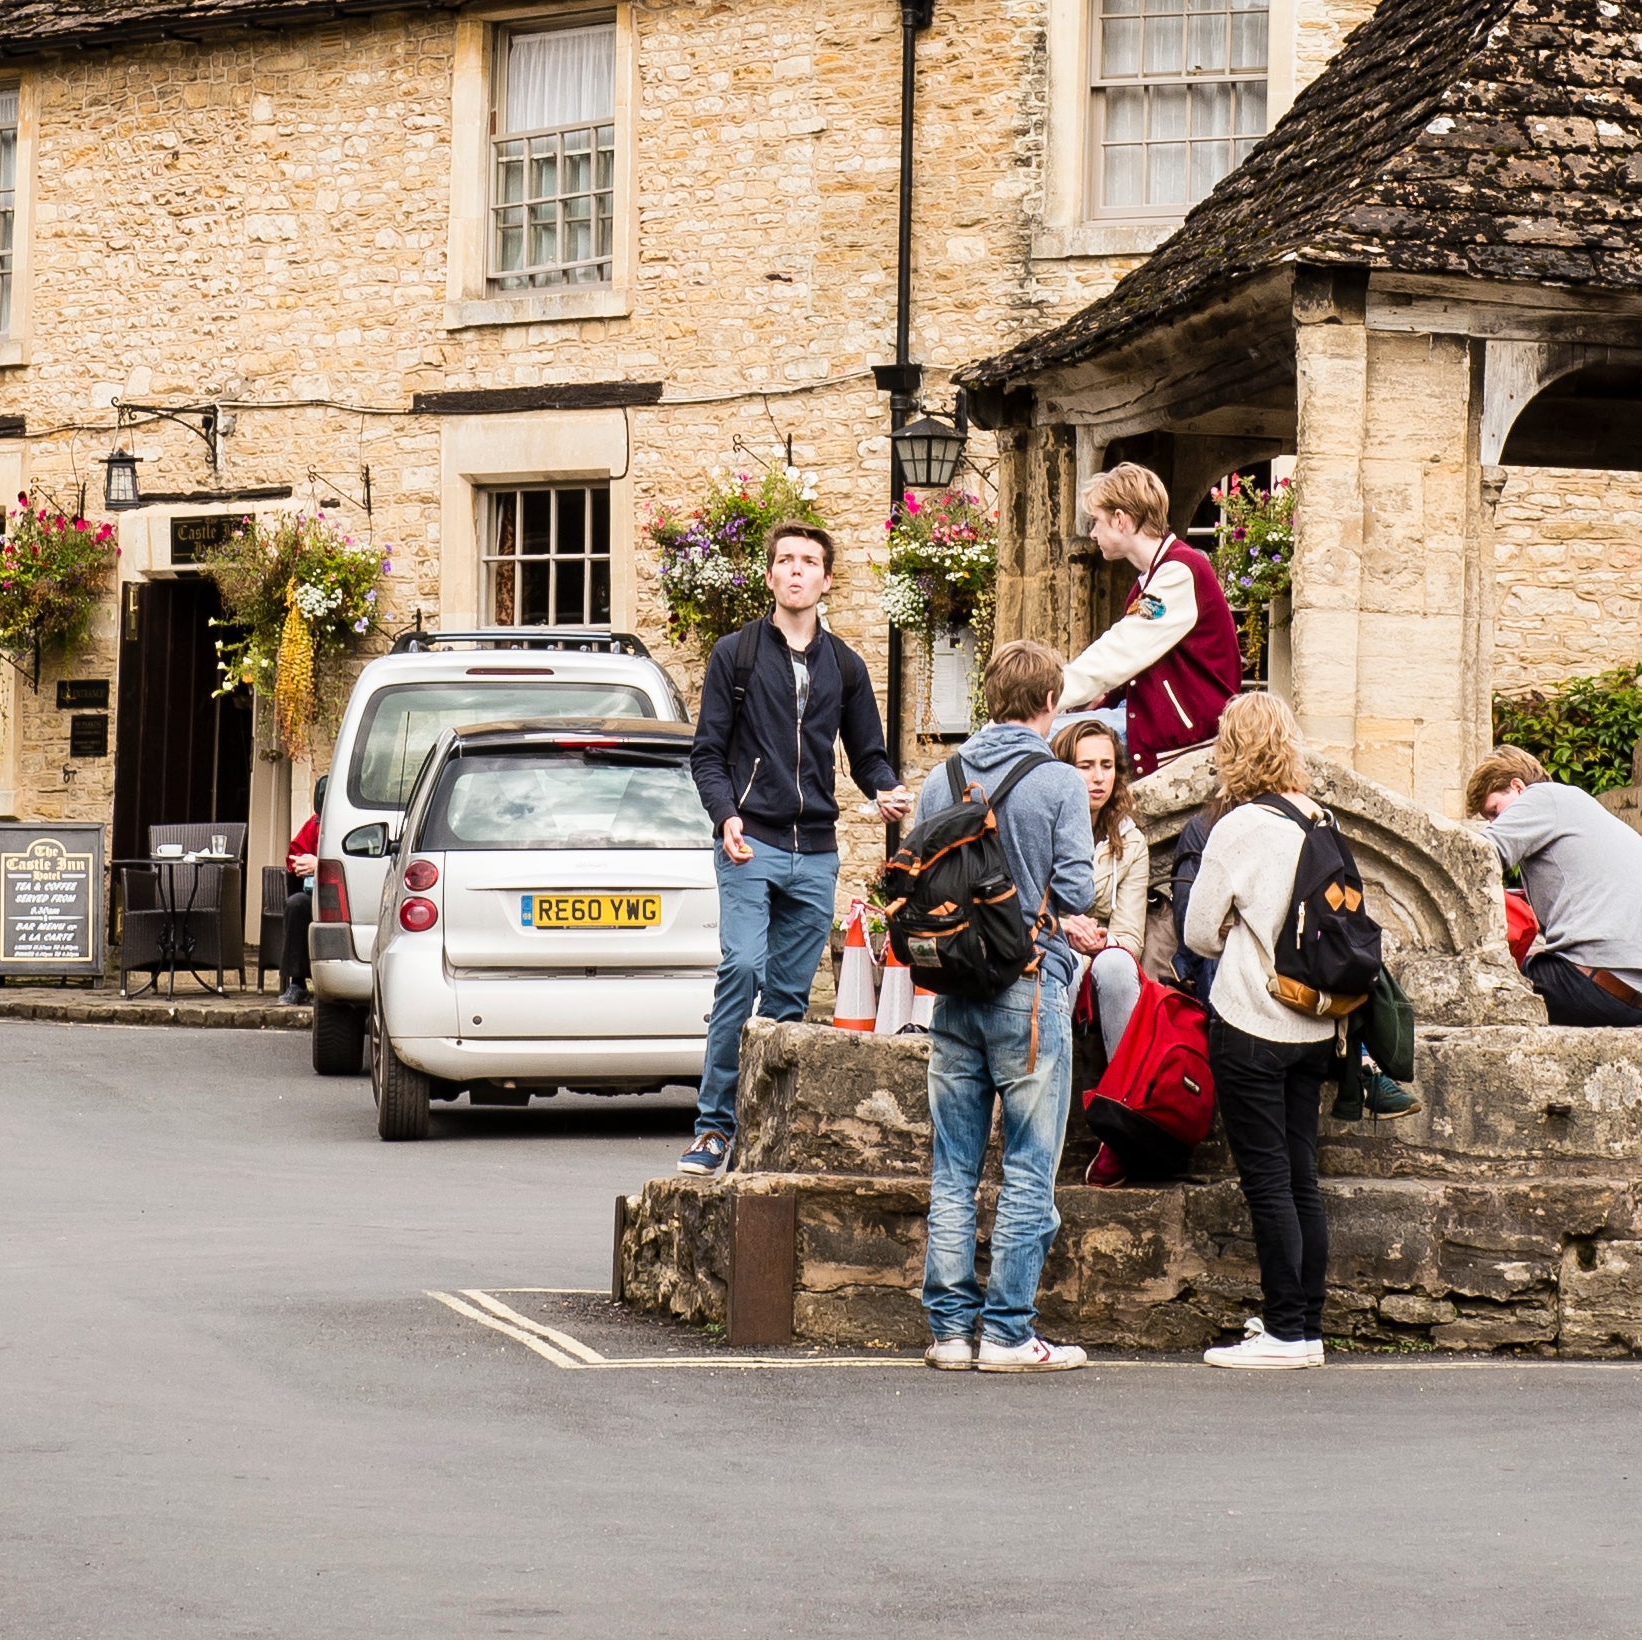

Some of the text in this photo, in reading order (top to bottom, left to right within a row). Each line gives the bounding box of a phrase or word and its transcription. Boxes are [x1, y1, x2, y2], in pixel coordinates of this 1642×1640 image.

[177, 524, 217, 541] Castle
[34, 845, 59, 858] The
[6, 857, 86, 871] Castle Inn
[33, 870, 61, 881] Hotel
[15, 881, 78, 891] TEA & COFFEE
[15, 893, 77, 903] SERVED FROM
[538, 898, 657, 921] RE60 YWG
[15, 922, 36, 931] BAR
[37, 922, 66, 931] MENU
[18, 933, 75, 941] A LA CARTE
